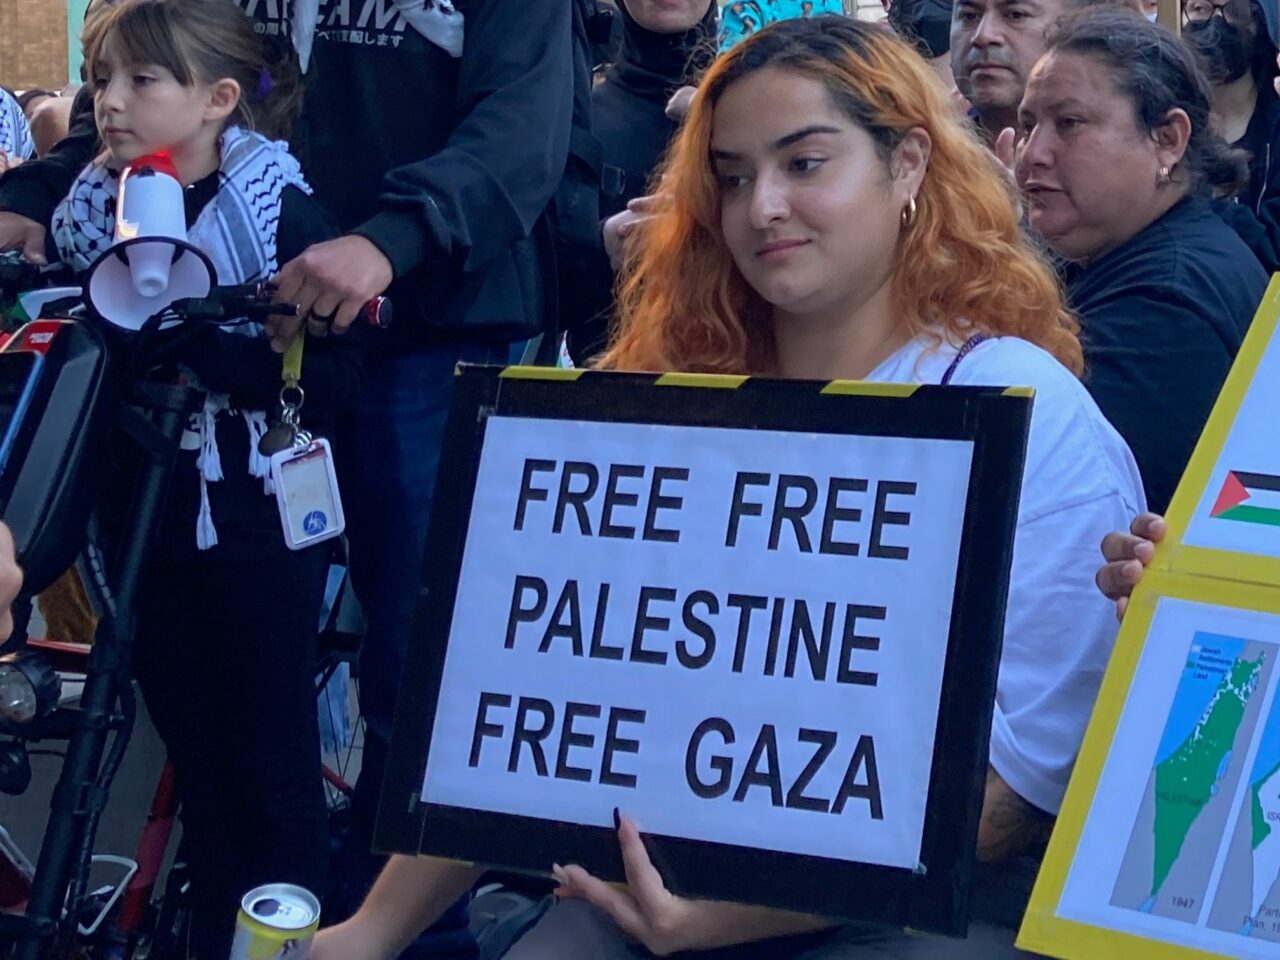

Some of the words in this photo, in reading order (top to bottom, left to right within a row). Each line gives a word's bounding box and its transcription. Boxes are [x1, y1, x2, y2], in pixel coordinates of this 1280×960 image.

[513, 458, 690, 543] FREE
[725, 471, 917, 560] FREE
[504, 574, 888, 687] PALESTINE
[468, 691, 647, 788] FREE
[685, 717, 884, 820] GAZA
[1172, 896, 1195, 909] 1947
